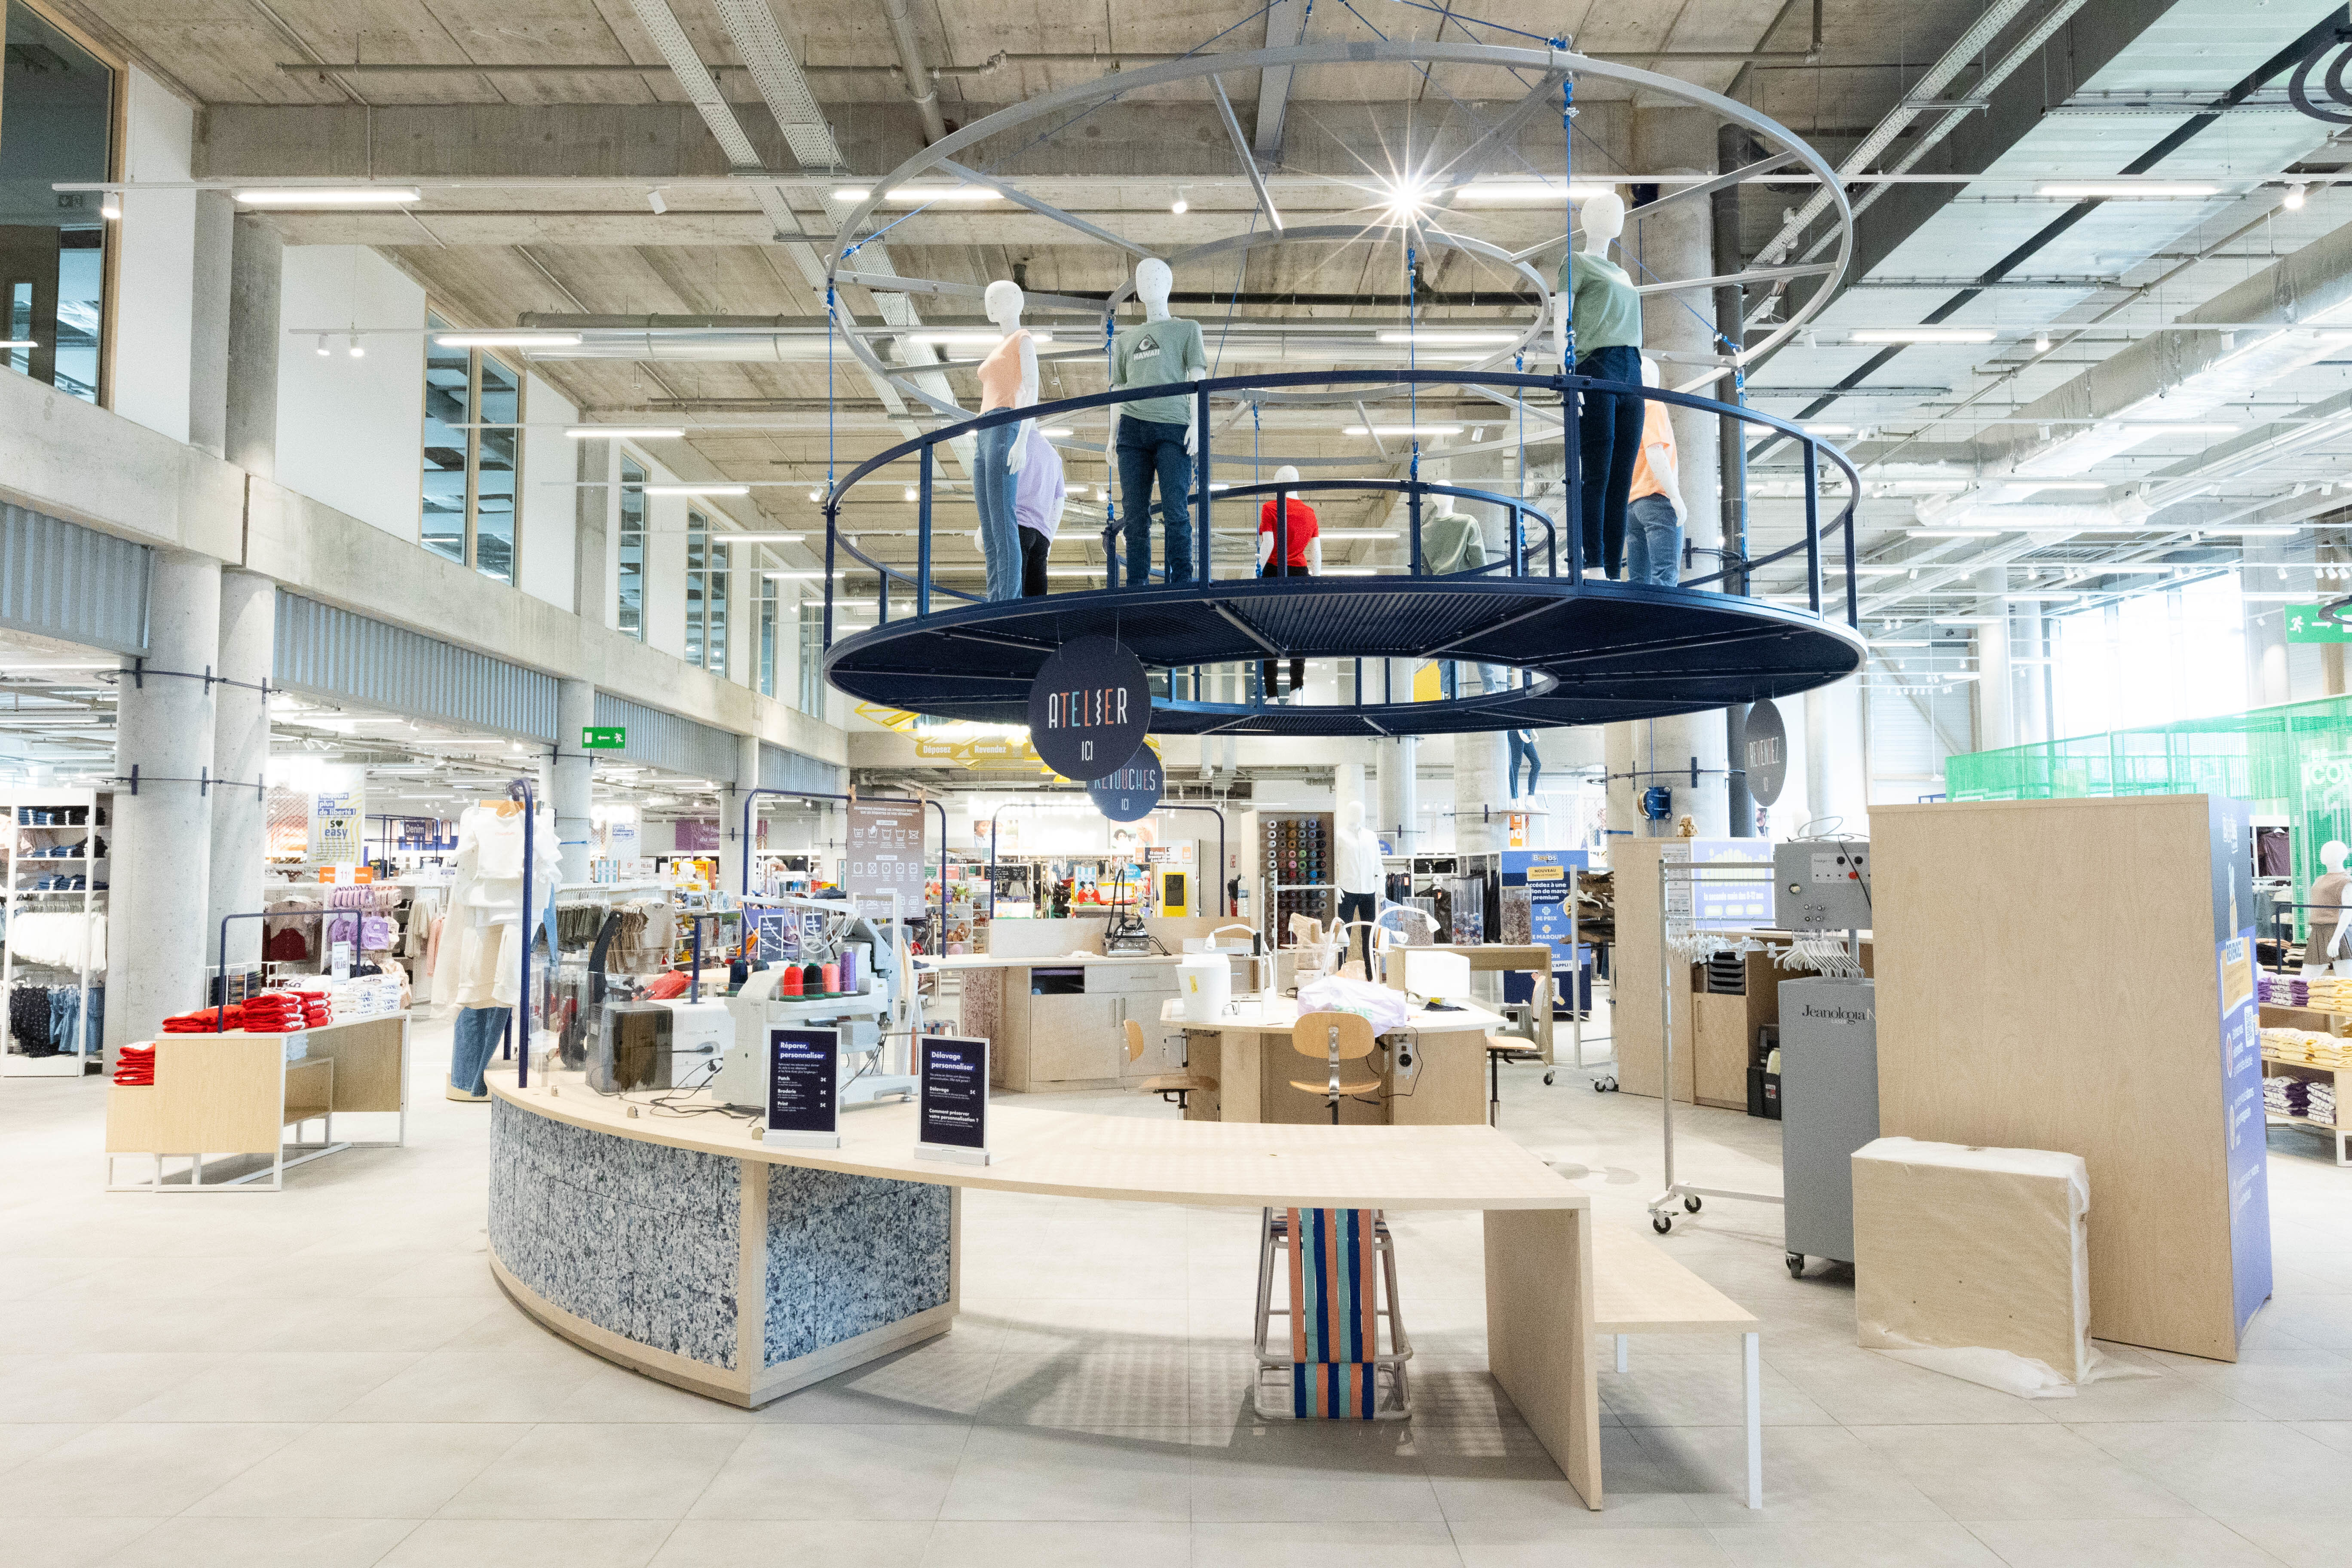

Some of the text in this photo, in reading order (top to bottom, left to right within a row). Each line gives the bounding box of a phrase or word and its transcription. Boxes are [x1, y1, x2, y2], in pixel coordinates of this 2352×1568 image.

[1133, 349, 1160, 360] HAWAII
[1048, 687, 1127, 729] ATELIER
[923, 745, 951, 754] Déposez
[974, 745, 1006, 754] Revendez
[1081, 741, 1093, 761] ICI
[1749, 737, 1779, 767] REVENDEZ
[406, 824, 424, 833] Denim
[325, 829, 348, 840] easy
[1802, 1004, 1865, 1025] Jeanologia
[931, 1051, 961, 1061] Délavage
